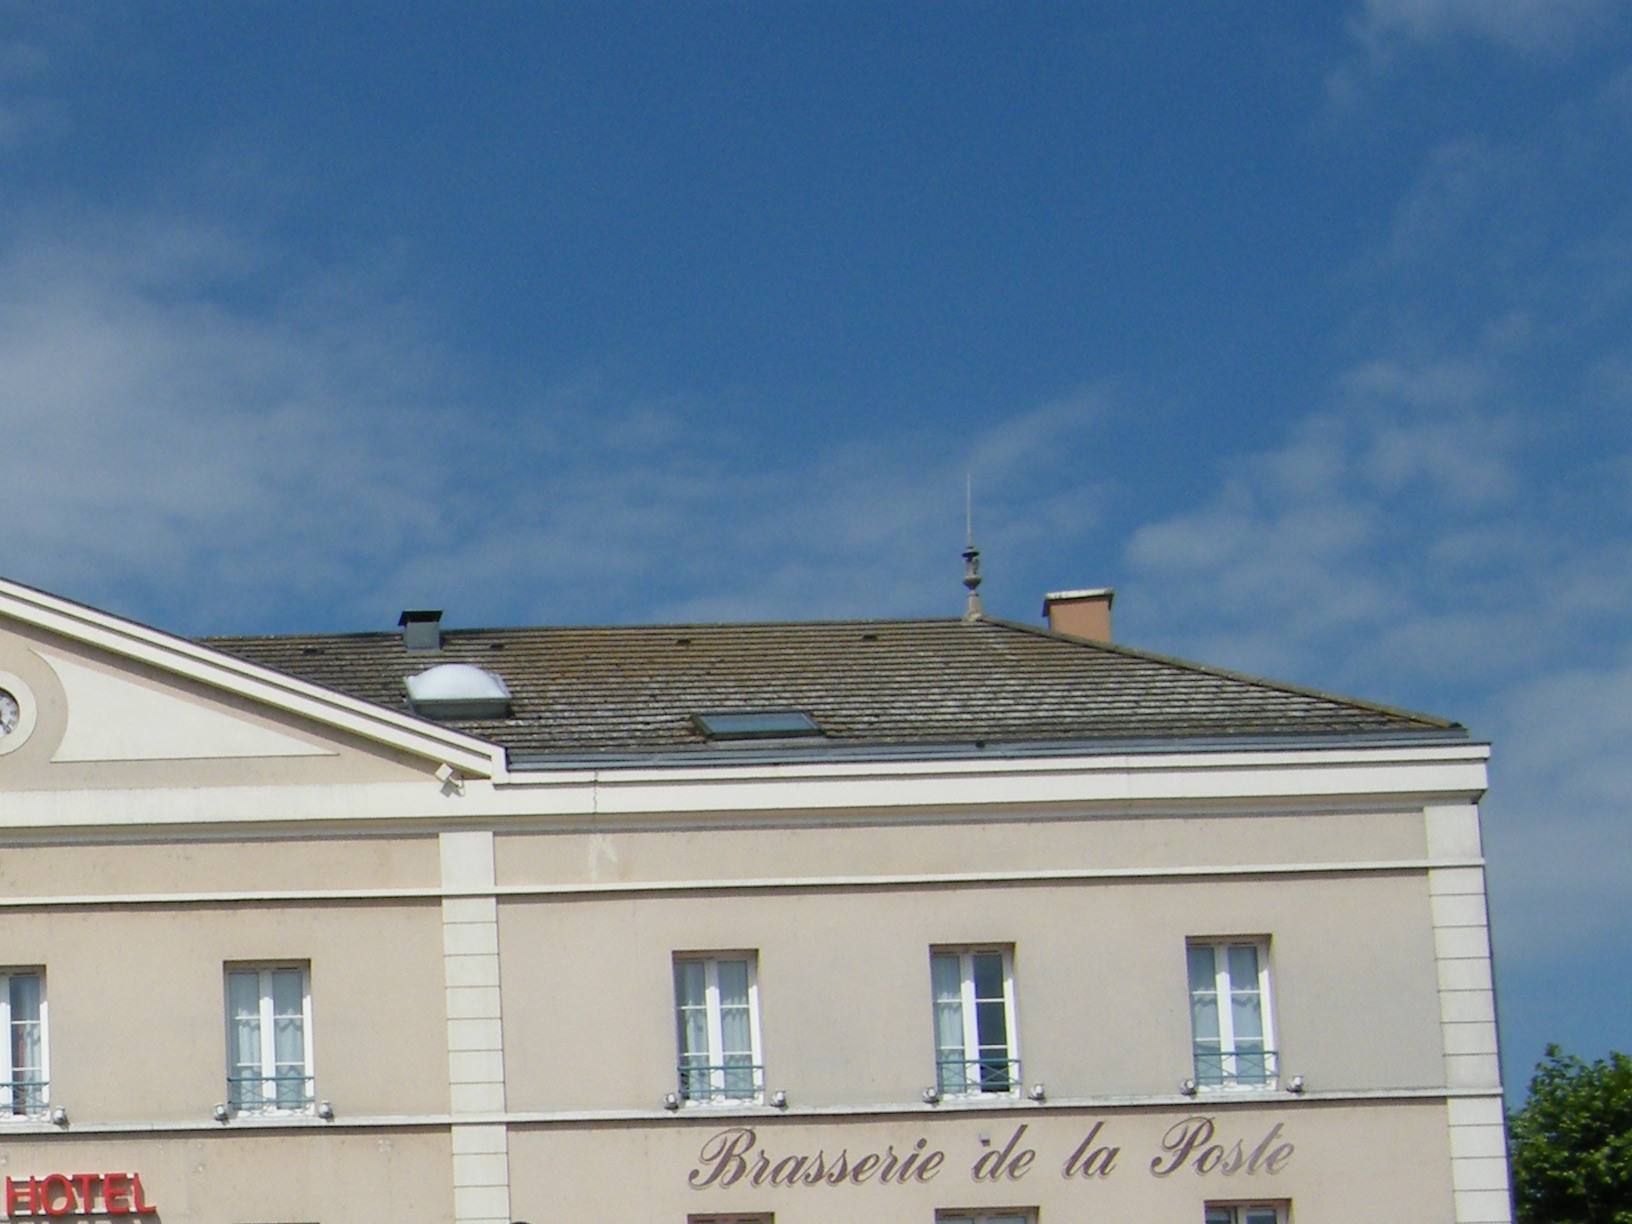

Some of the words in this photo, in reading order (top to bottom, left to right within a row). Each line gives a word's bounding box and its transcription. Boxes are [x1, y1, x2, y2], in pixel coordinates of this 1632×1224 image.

[688, 1128, 946, 1190] Brasserie
[971, 1124, 1035, 1183] de
[1063, 1121, 1120, 1180] la
[1149, 1115, 1295, 1177] Poste
[6, 1173, 157, 1216] HOTEL
